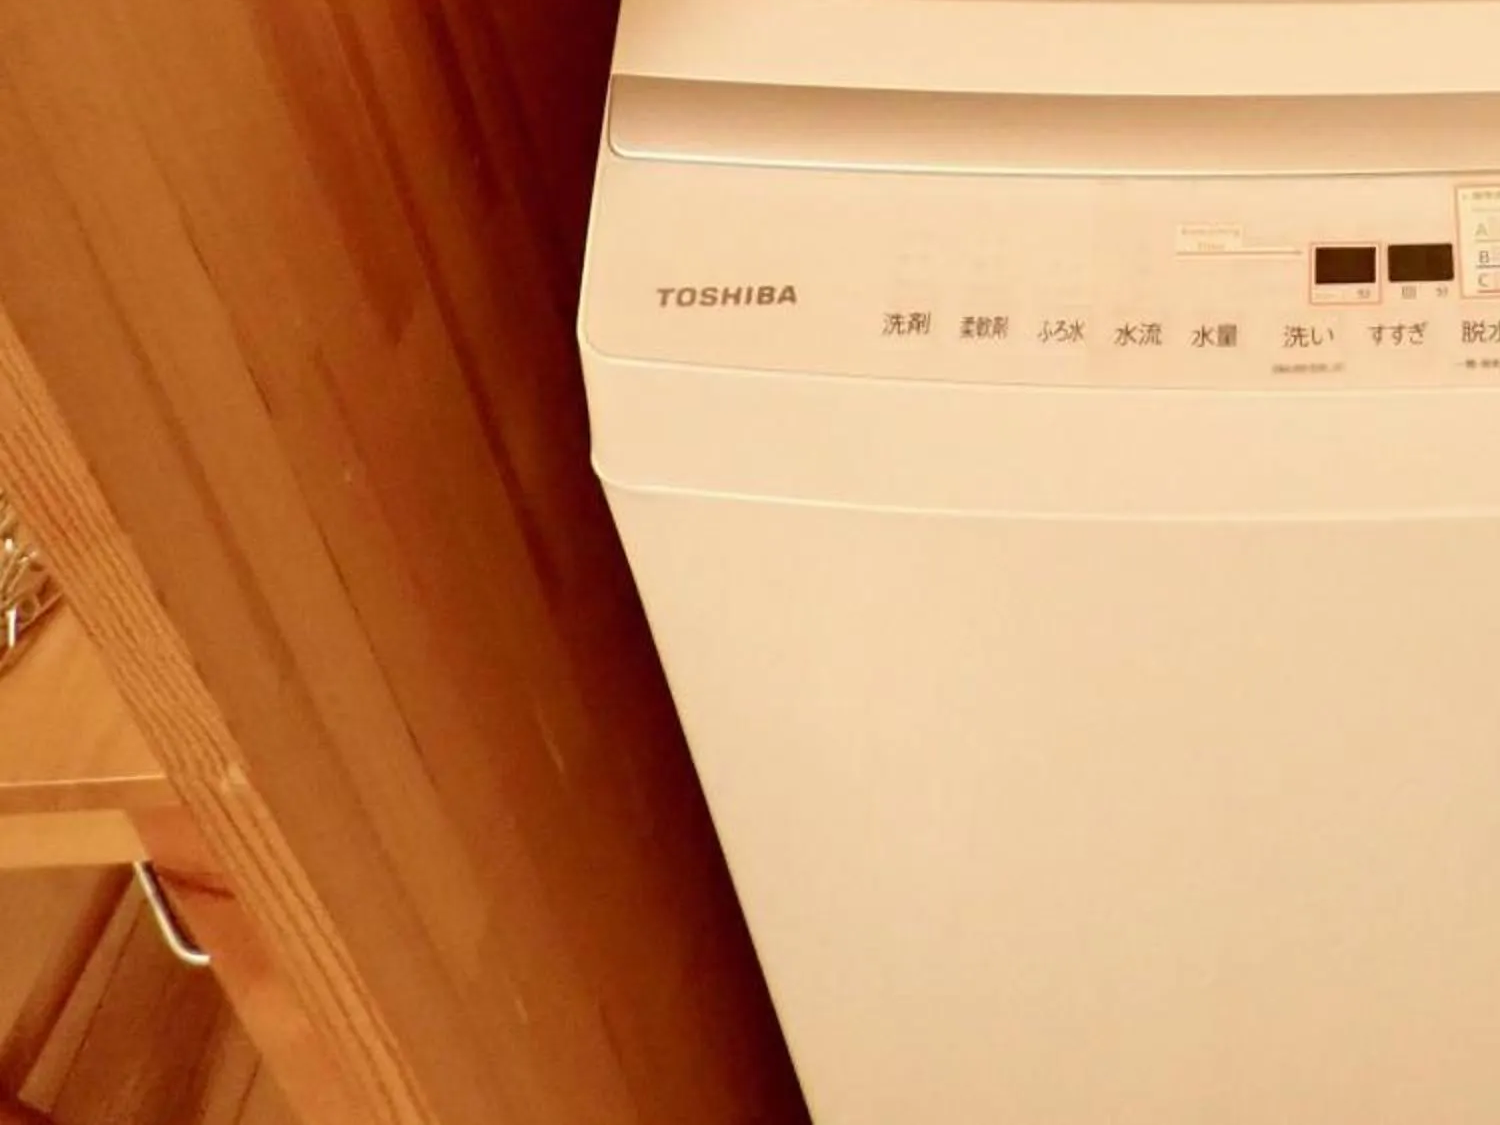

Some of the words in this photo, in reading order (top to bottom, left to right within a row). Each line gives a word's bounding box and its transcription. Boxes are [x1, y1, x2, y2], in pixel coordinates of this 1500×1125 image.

[1478, 250, 1490, 265] B
[1477, 274, 1489, 288] C
[656, 284, 798, 308] TOSHIBA
[881, 311, 932, 336] 洗剤
[959, 315, 1010, 339] 柔軟剤
[1037, 319, 1086, 343] ふろ水
[1113, 322, 1163, 346] 水流
[1367, 321, 1429, 346] すすぎ
[1282, 325, 1335, 349] 洗い
